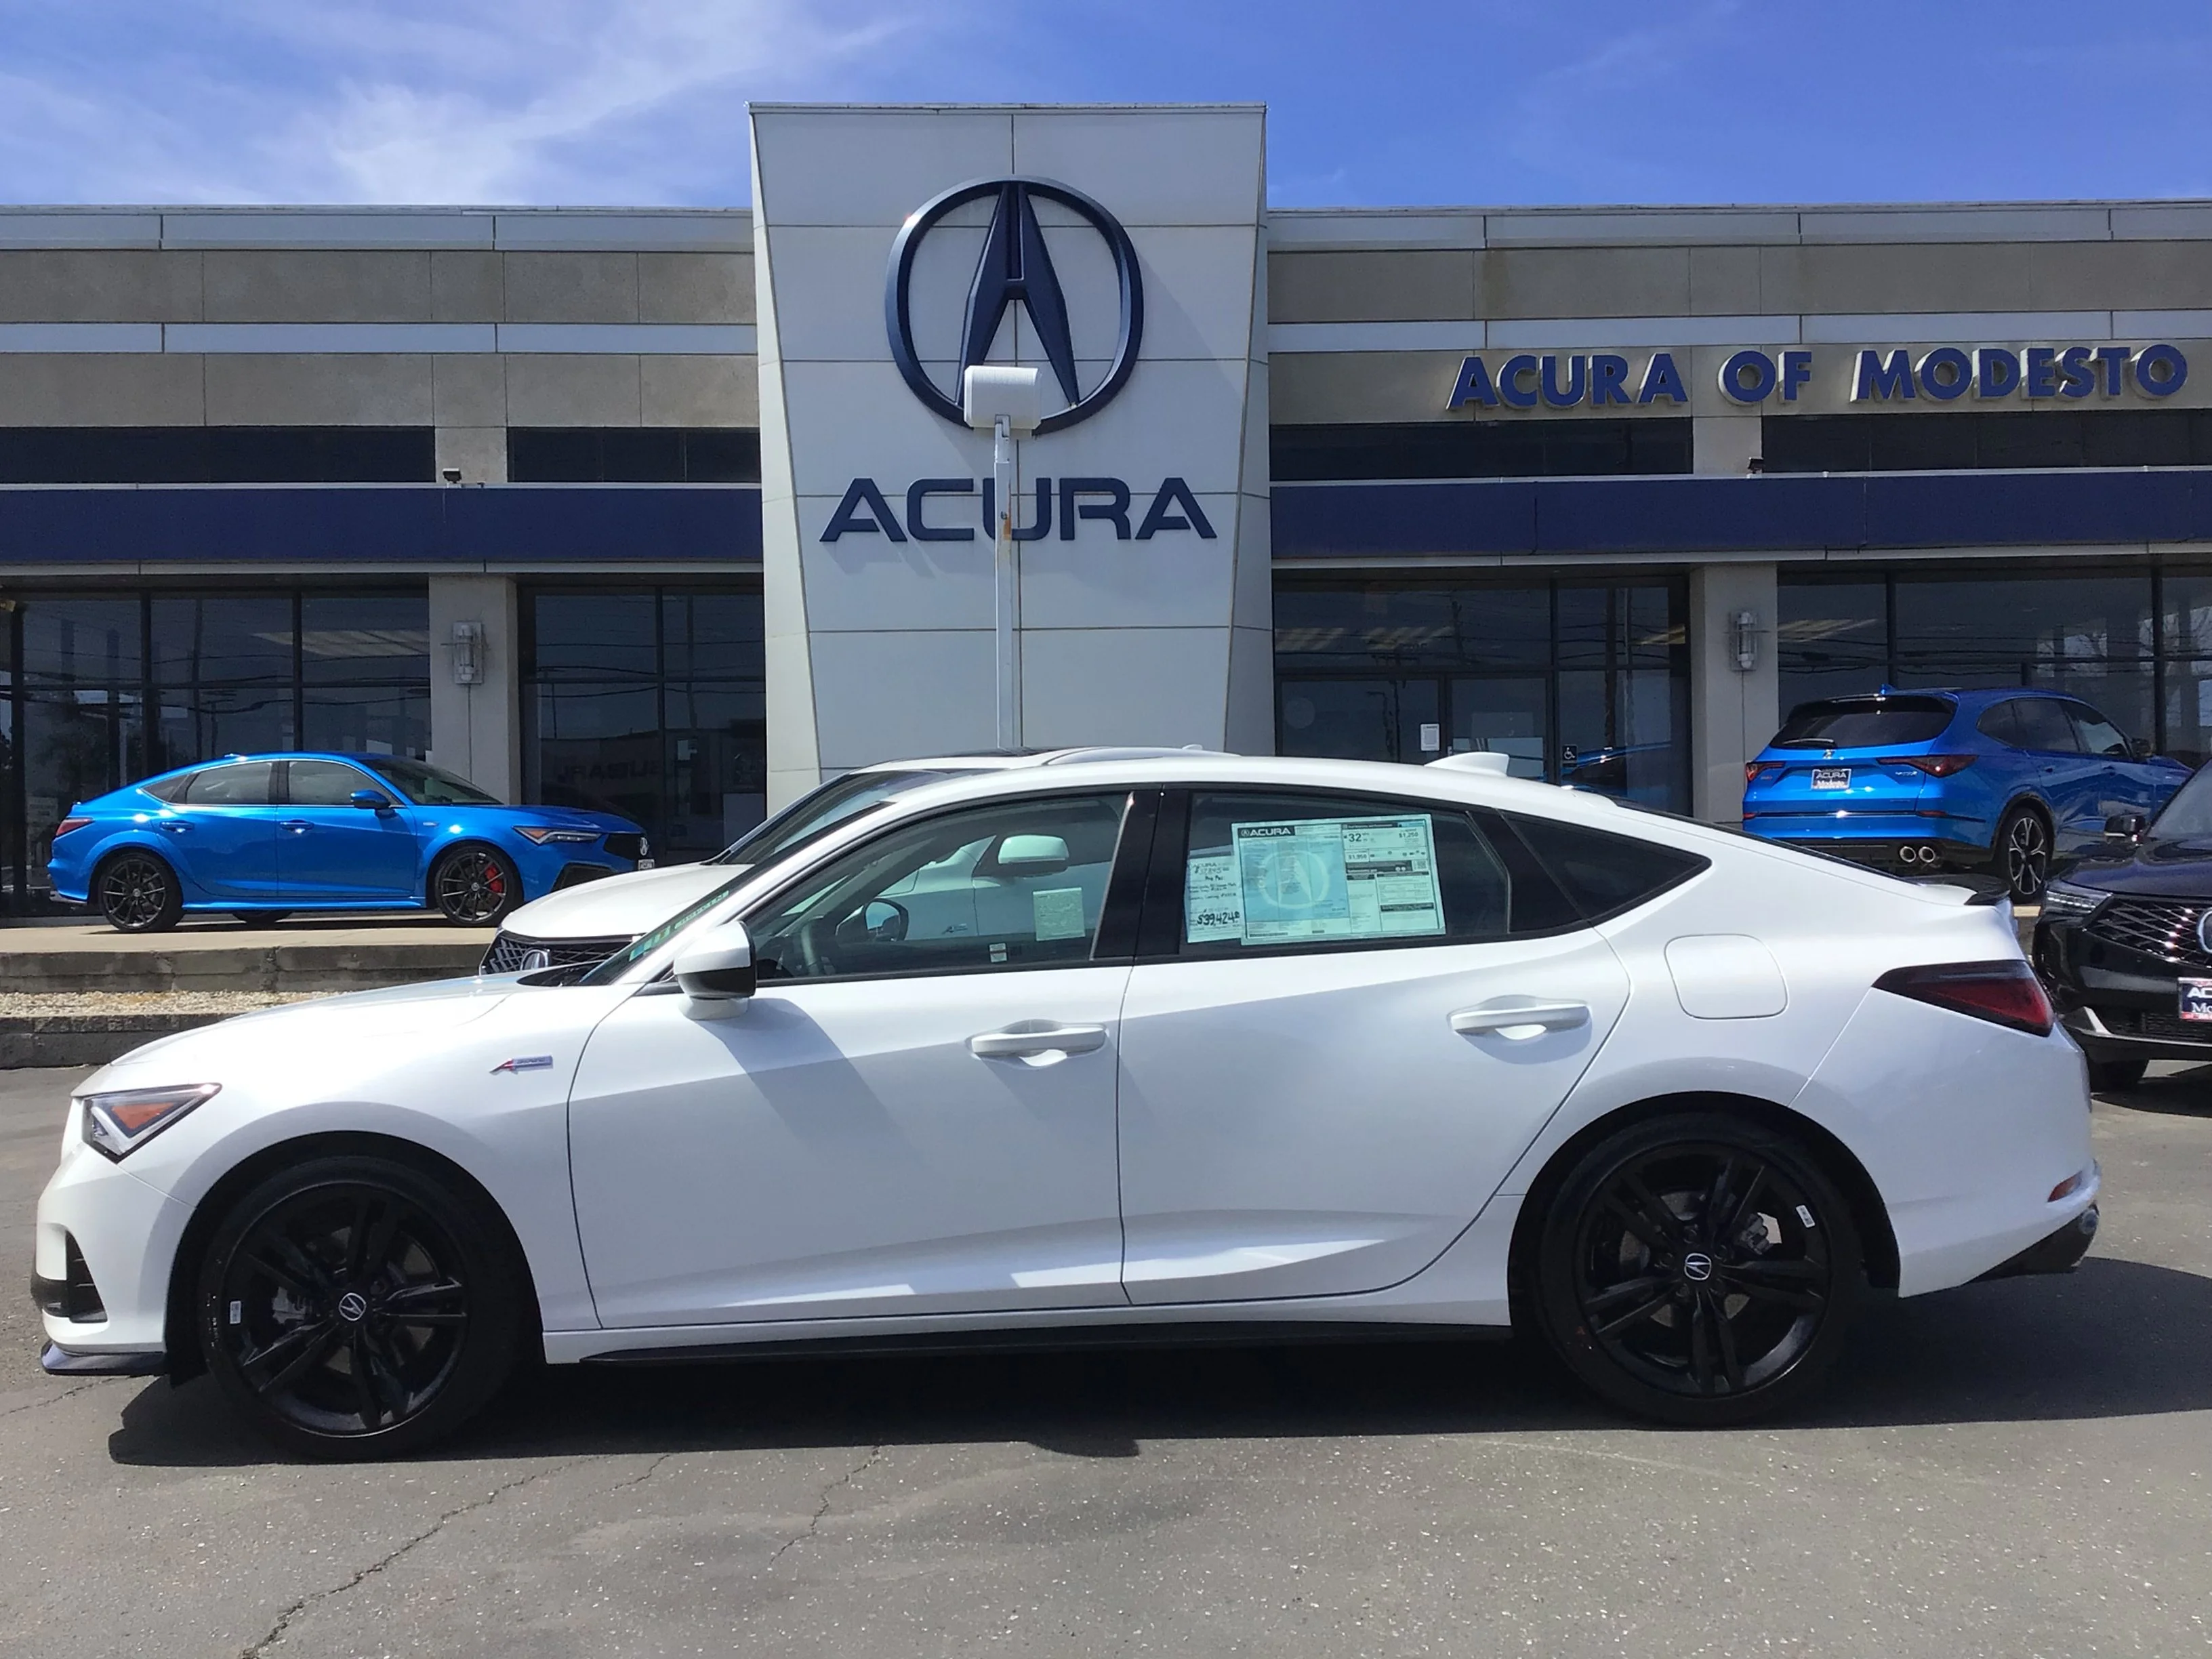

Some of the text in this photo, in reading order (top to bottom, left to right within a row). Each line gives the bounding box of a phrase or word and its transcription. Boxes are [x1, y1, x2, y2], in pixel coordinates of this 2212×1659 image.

[1446, 344, 2188, 409] ACURA OF MODESTO
[819, 477, 1218, 543] ACURA
[1250, 827, 1291, 836] ACURA
[1348, 833, 1361, 842] 32
